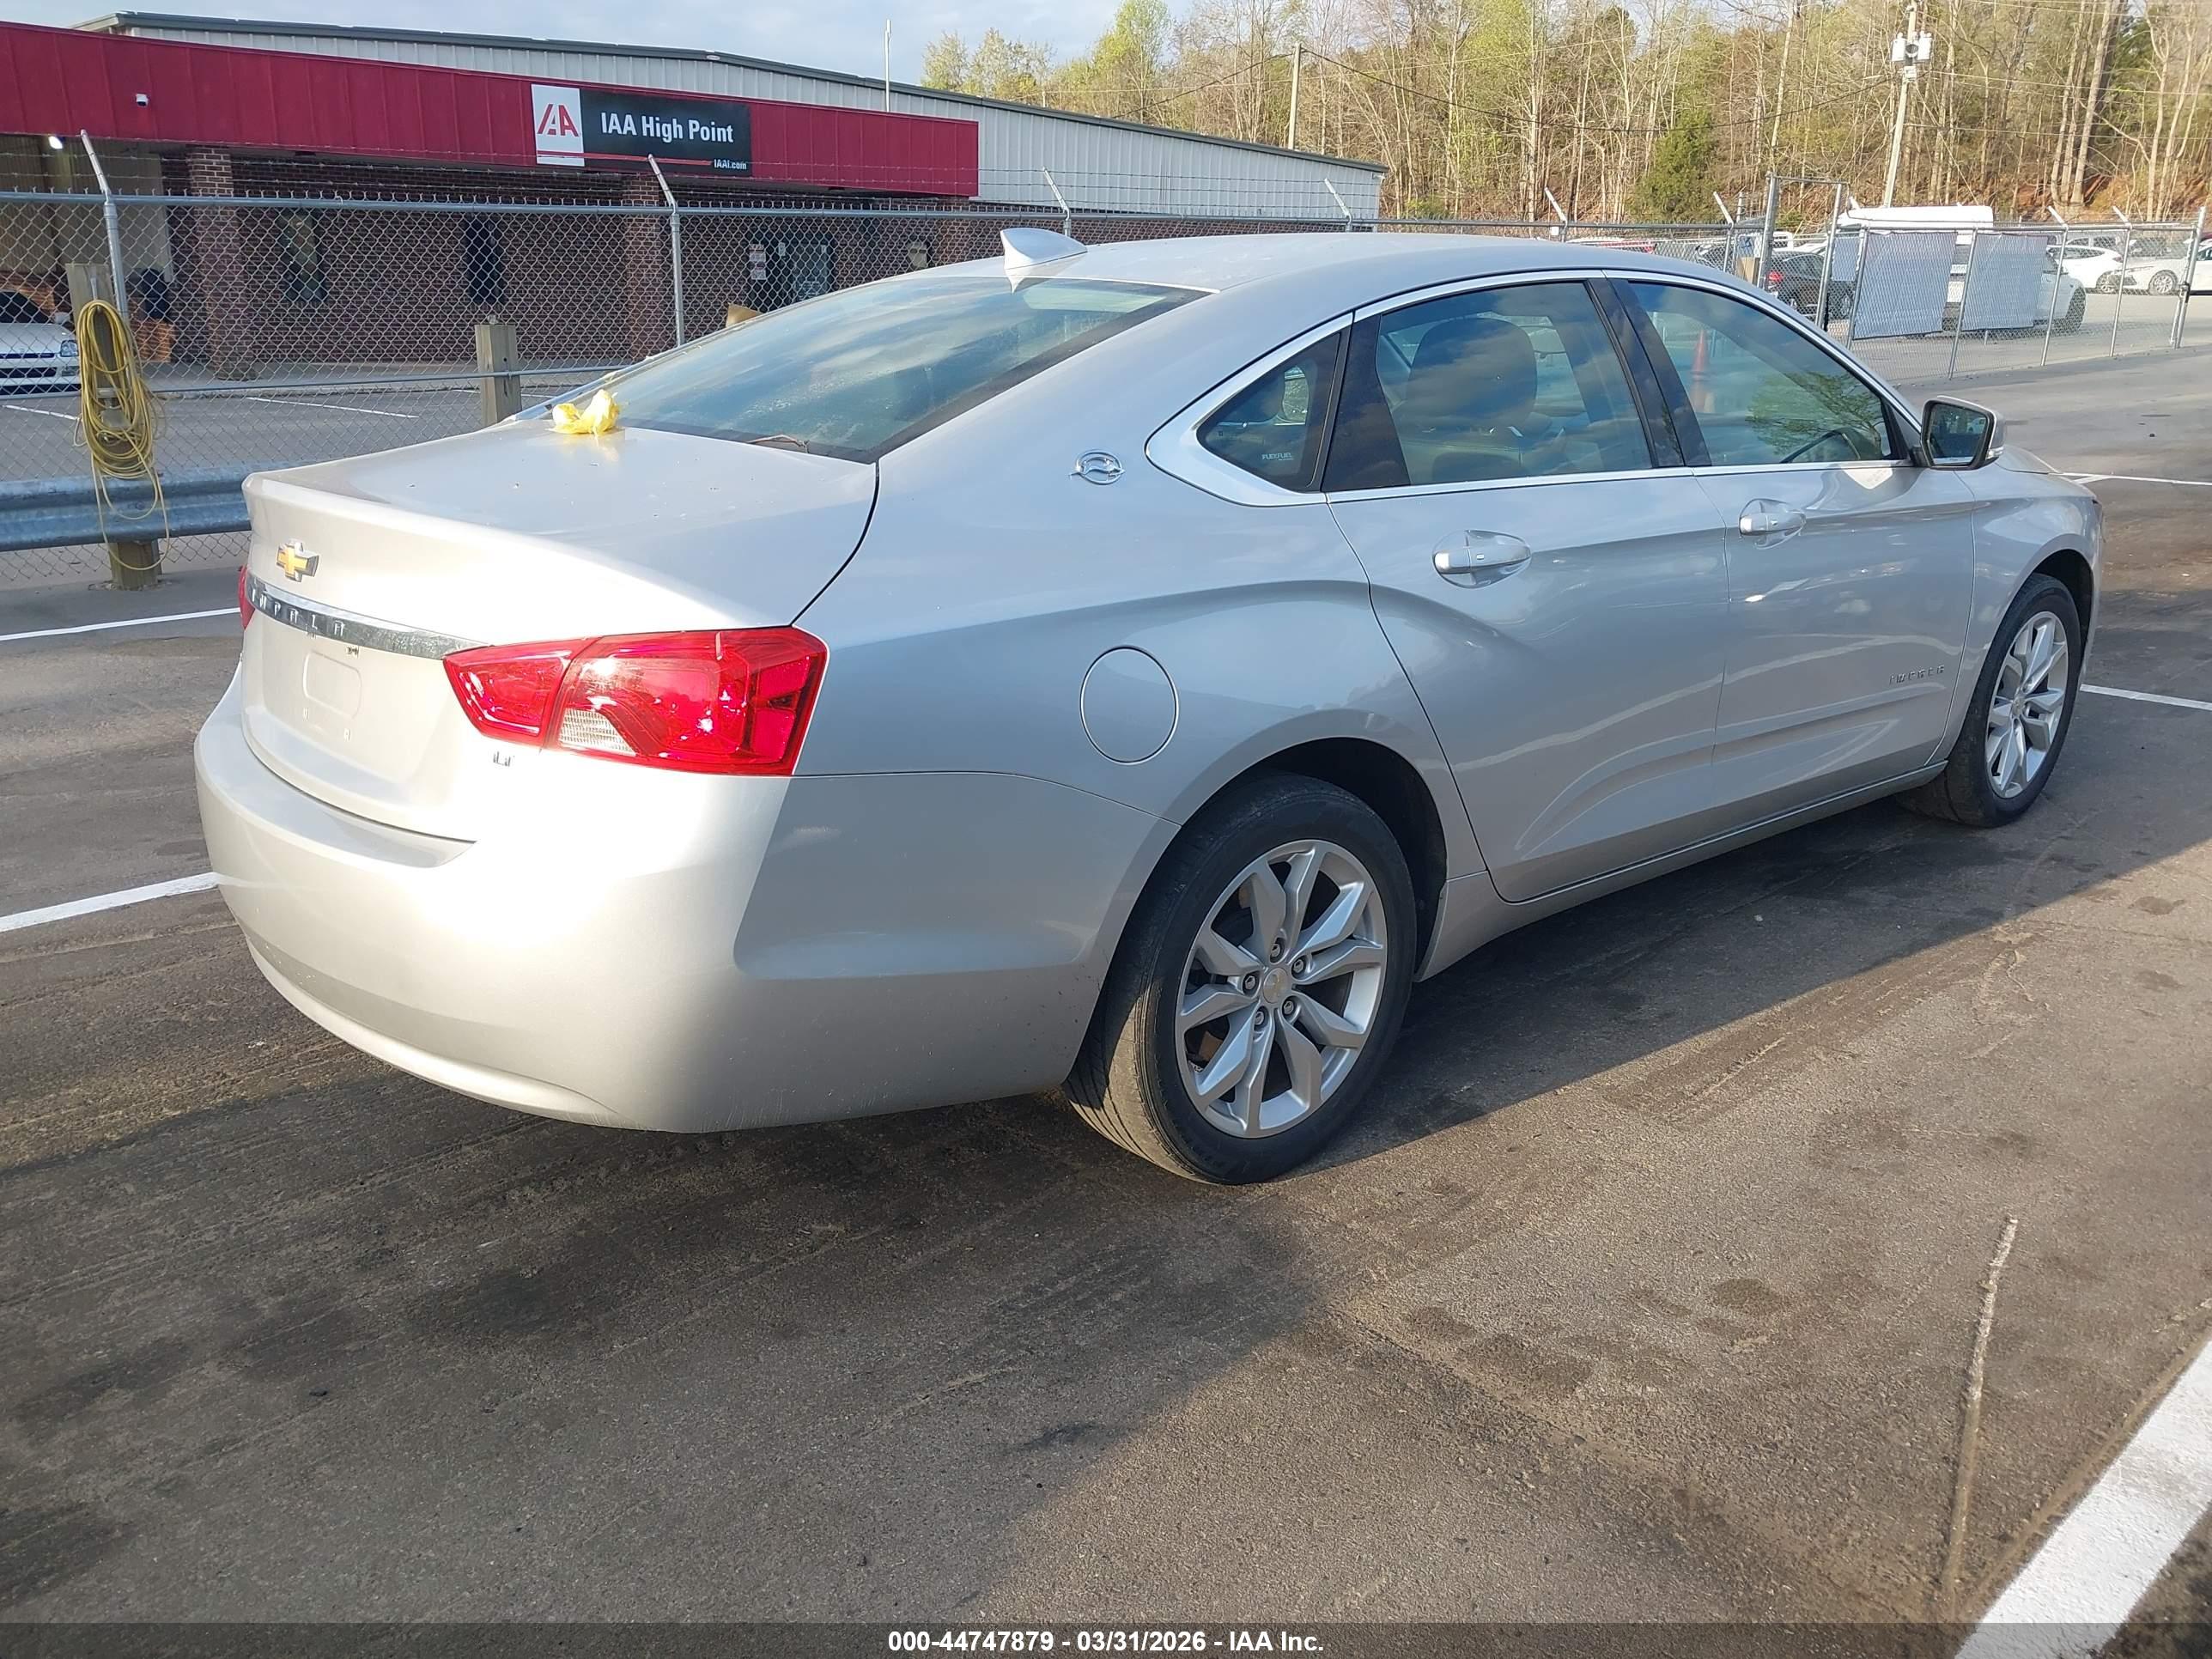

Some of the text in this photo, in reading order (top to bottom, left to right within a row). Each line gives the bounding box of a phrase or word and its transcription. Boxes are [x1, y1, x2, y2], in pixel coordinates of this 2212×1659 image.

[600, 112, 734, 143] IAA High Point
[252, 588, 345, 637] IMPALA
